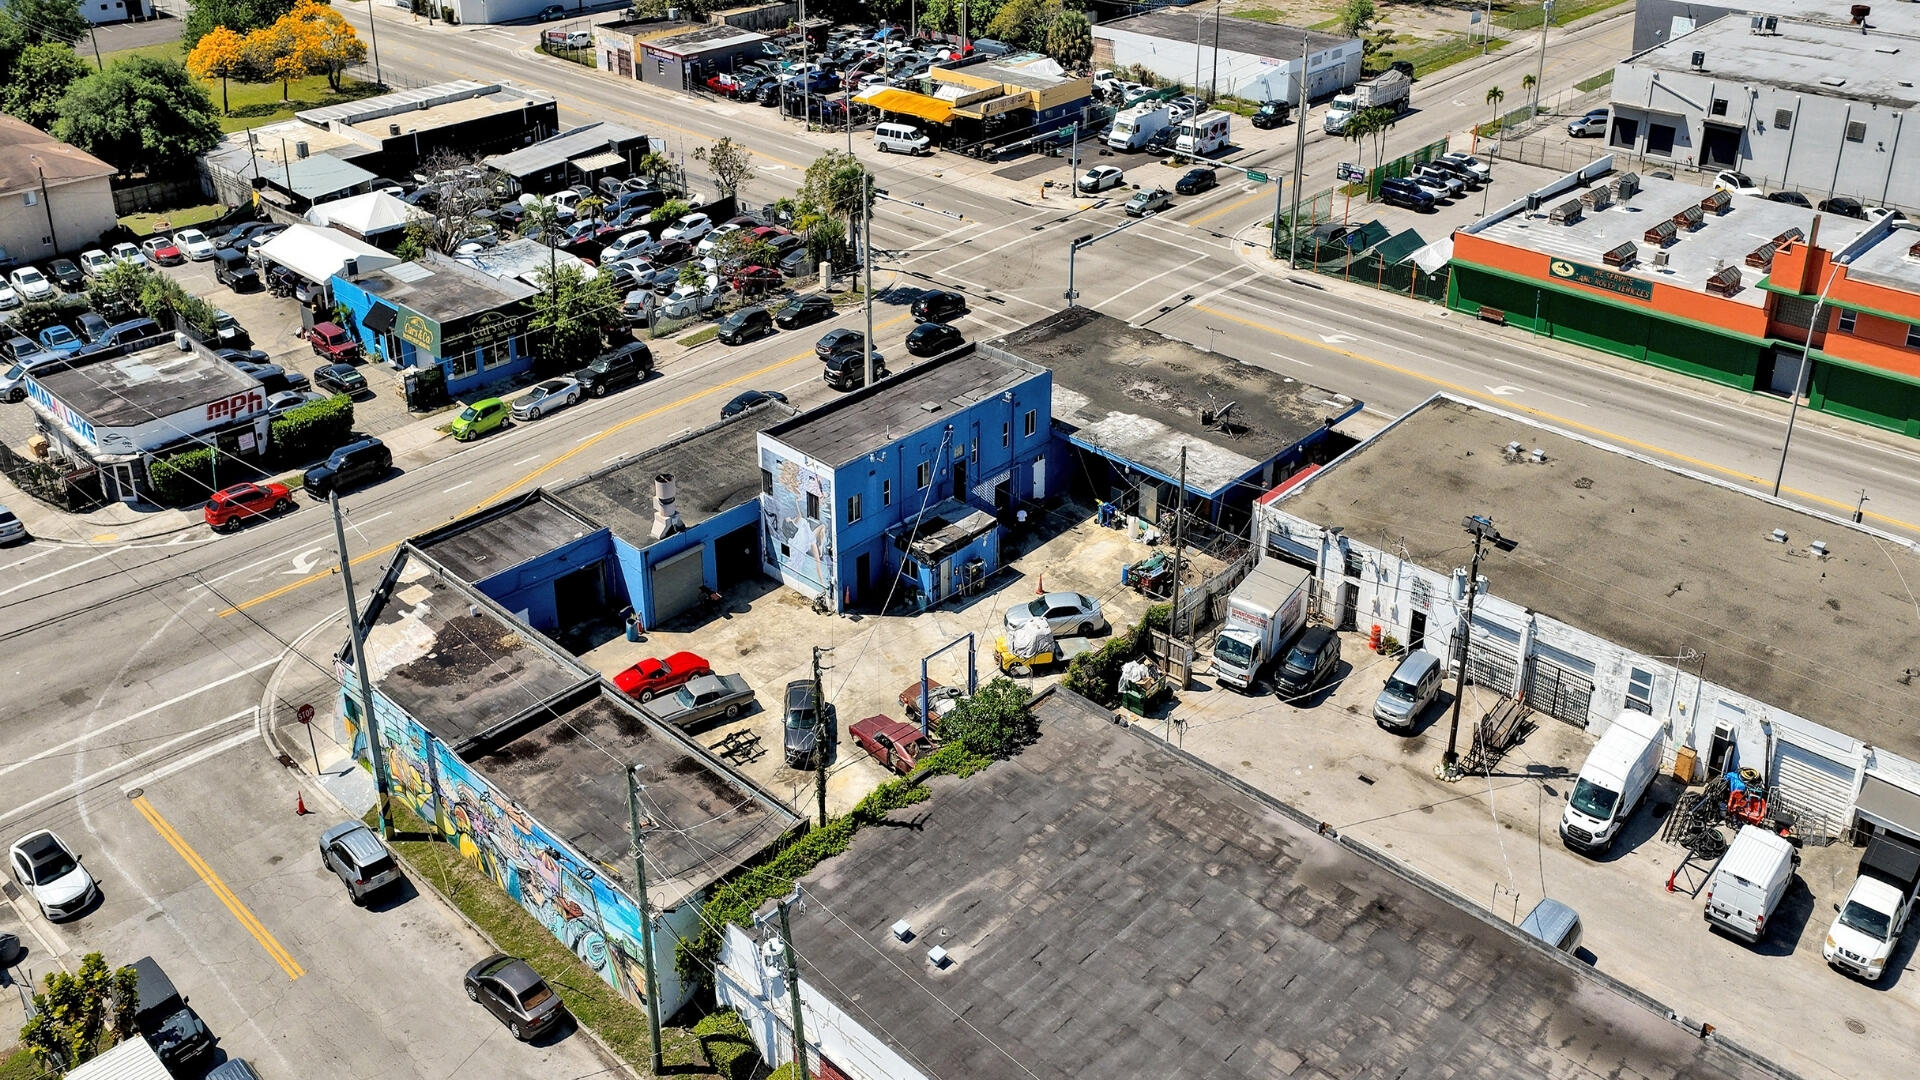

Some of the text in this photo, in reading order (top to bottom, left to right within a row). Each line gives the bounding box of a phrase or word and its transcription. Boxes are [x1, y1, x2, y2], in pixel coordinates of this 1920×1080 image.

[1593, 269, 1633, 286] WE SERVICE
[1595, 279, 1616, 289] ROVER
[1618, 285, 1649, 298] VEHICLES
[25, 377, 97, 446] MIAMI LUXE
[207, 391, 263, 421] mph
[298, 707, 313, 721] STOP
